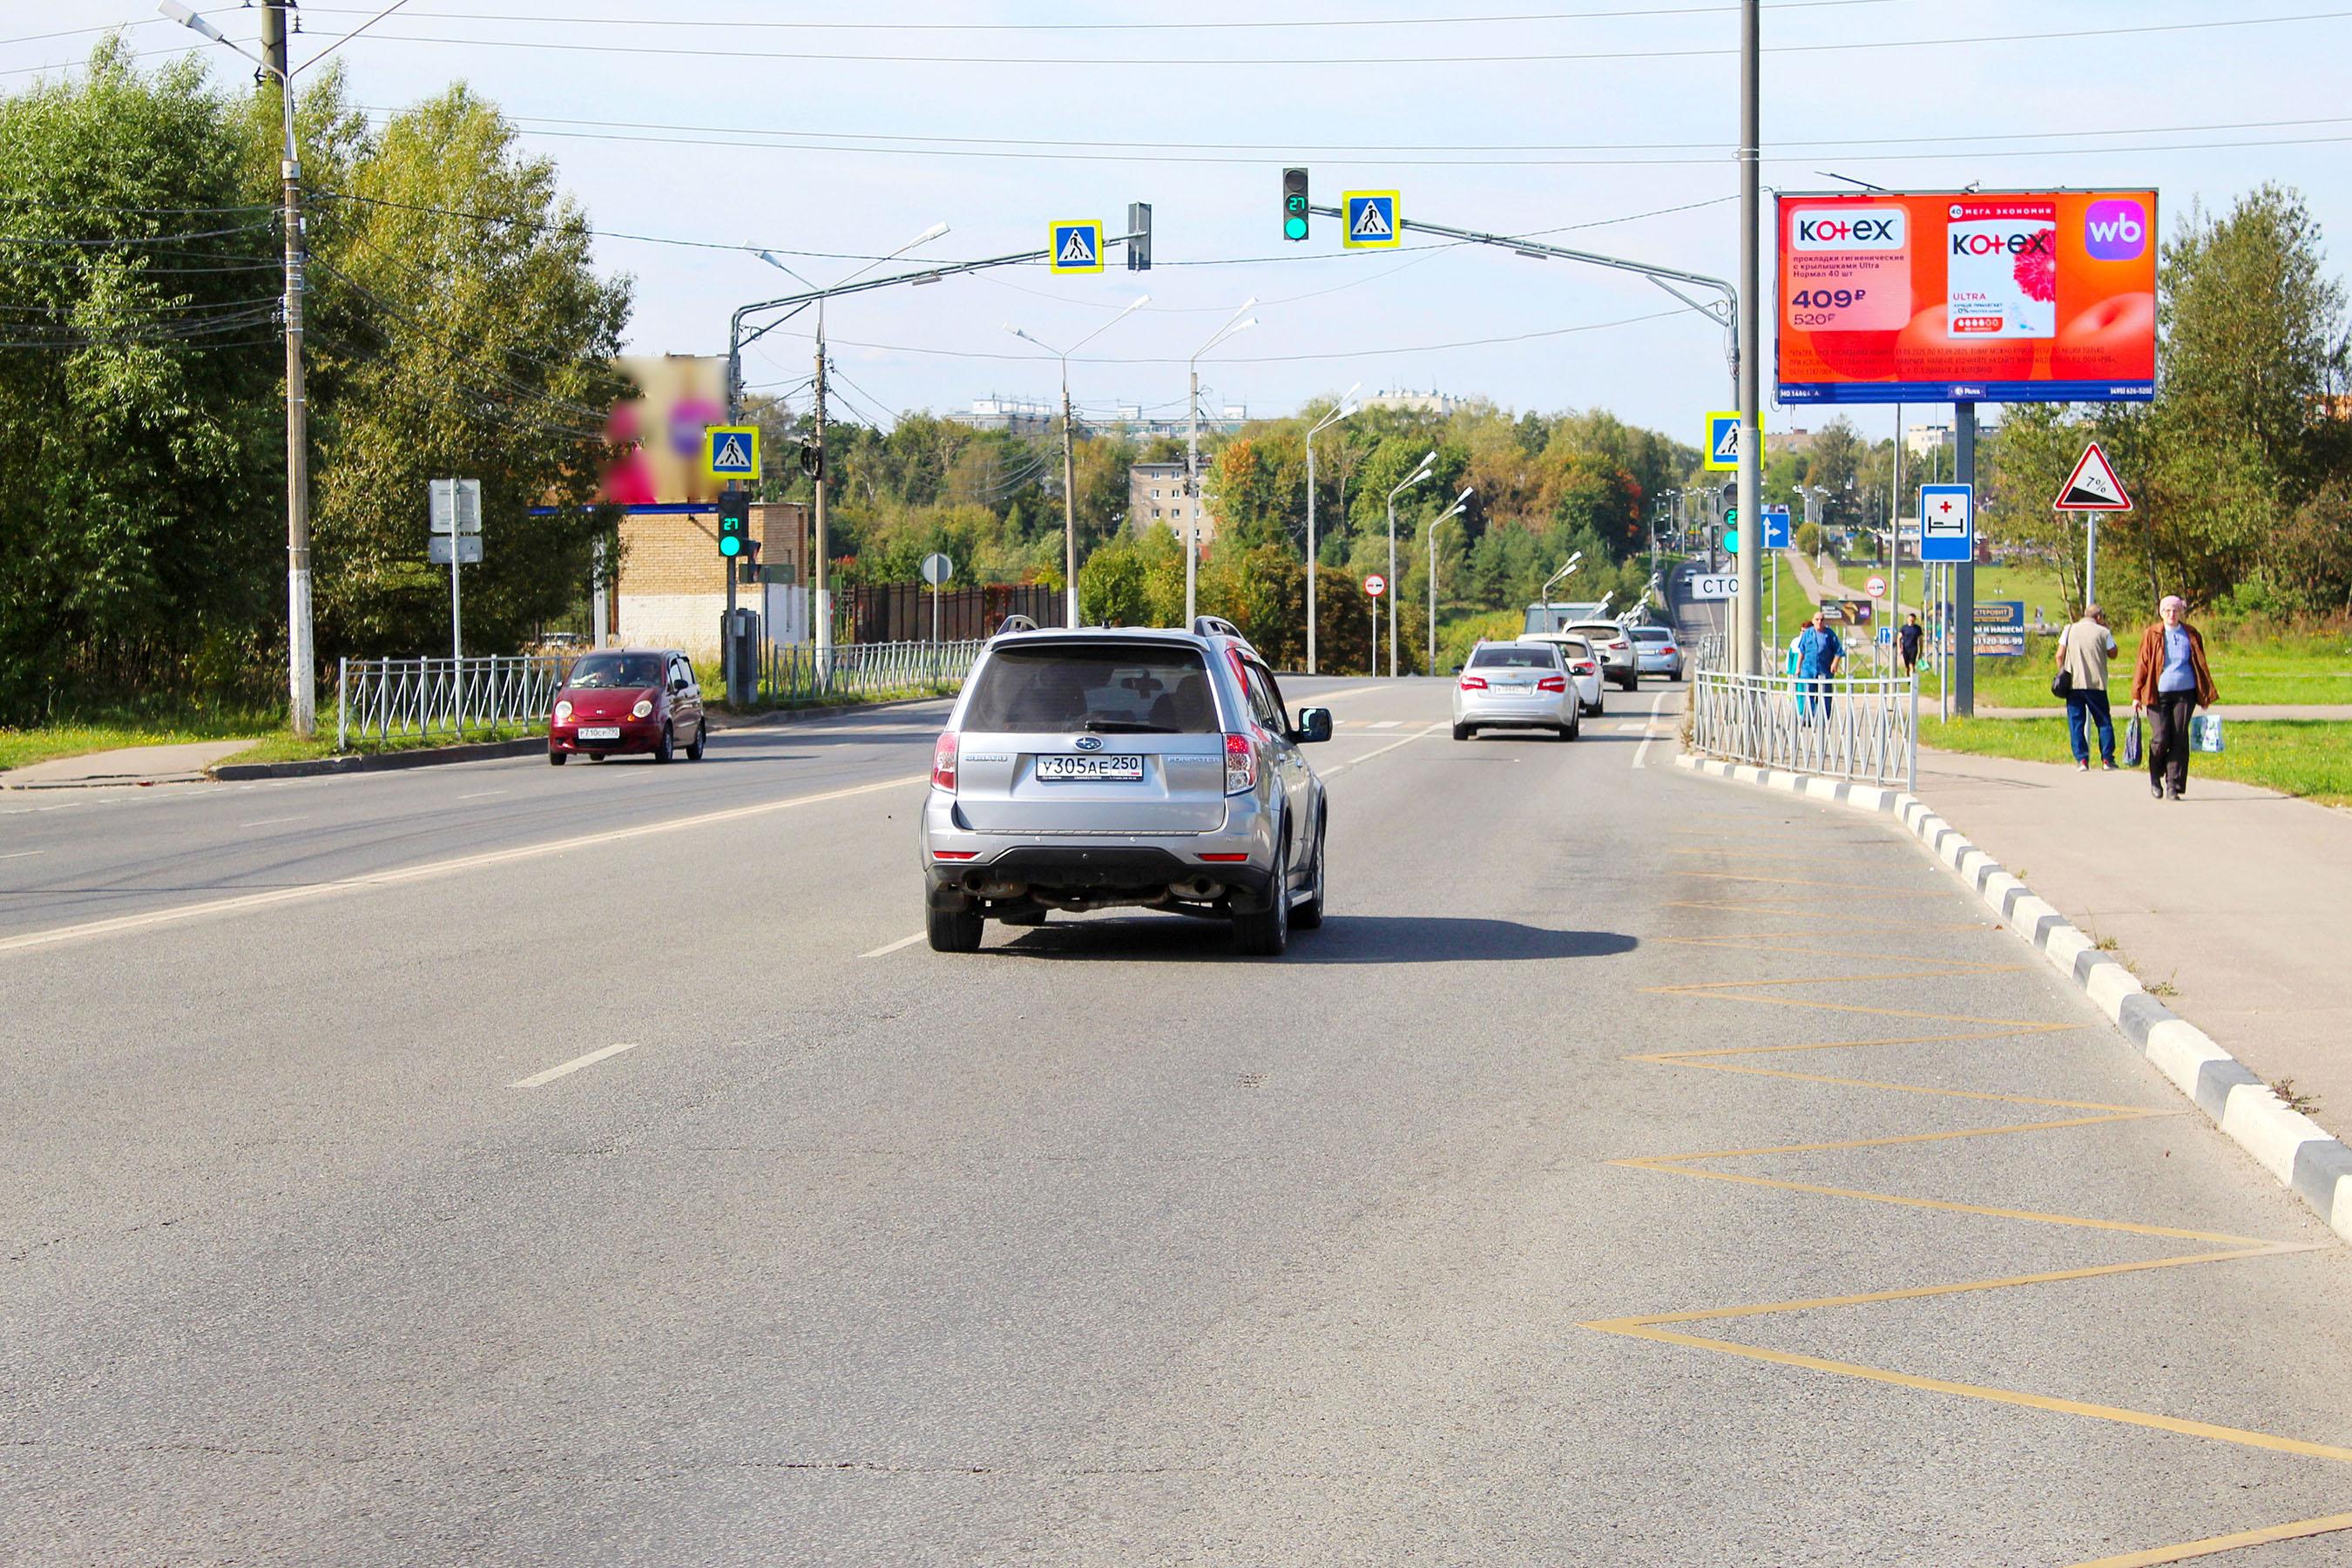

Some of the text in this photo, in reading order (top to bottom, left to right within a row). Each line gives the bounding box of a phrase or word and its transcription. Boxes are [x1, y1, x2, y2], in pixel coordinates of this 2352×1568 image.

[1289, 197, 1305, 211] 27
[2089, 212, 2141, 243] wb
[2086, 476, 2106, 493] 7%
[724, 517, 739, 531] 27
[1703, 579, 1738, 593] СТО
[1044, 757, 1138, 774] У305АЕ 250
